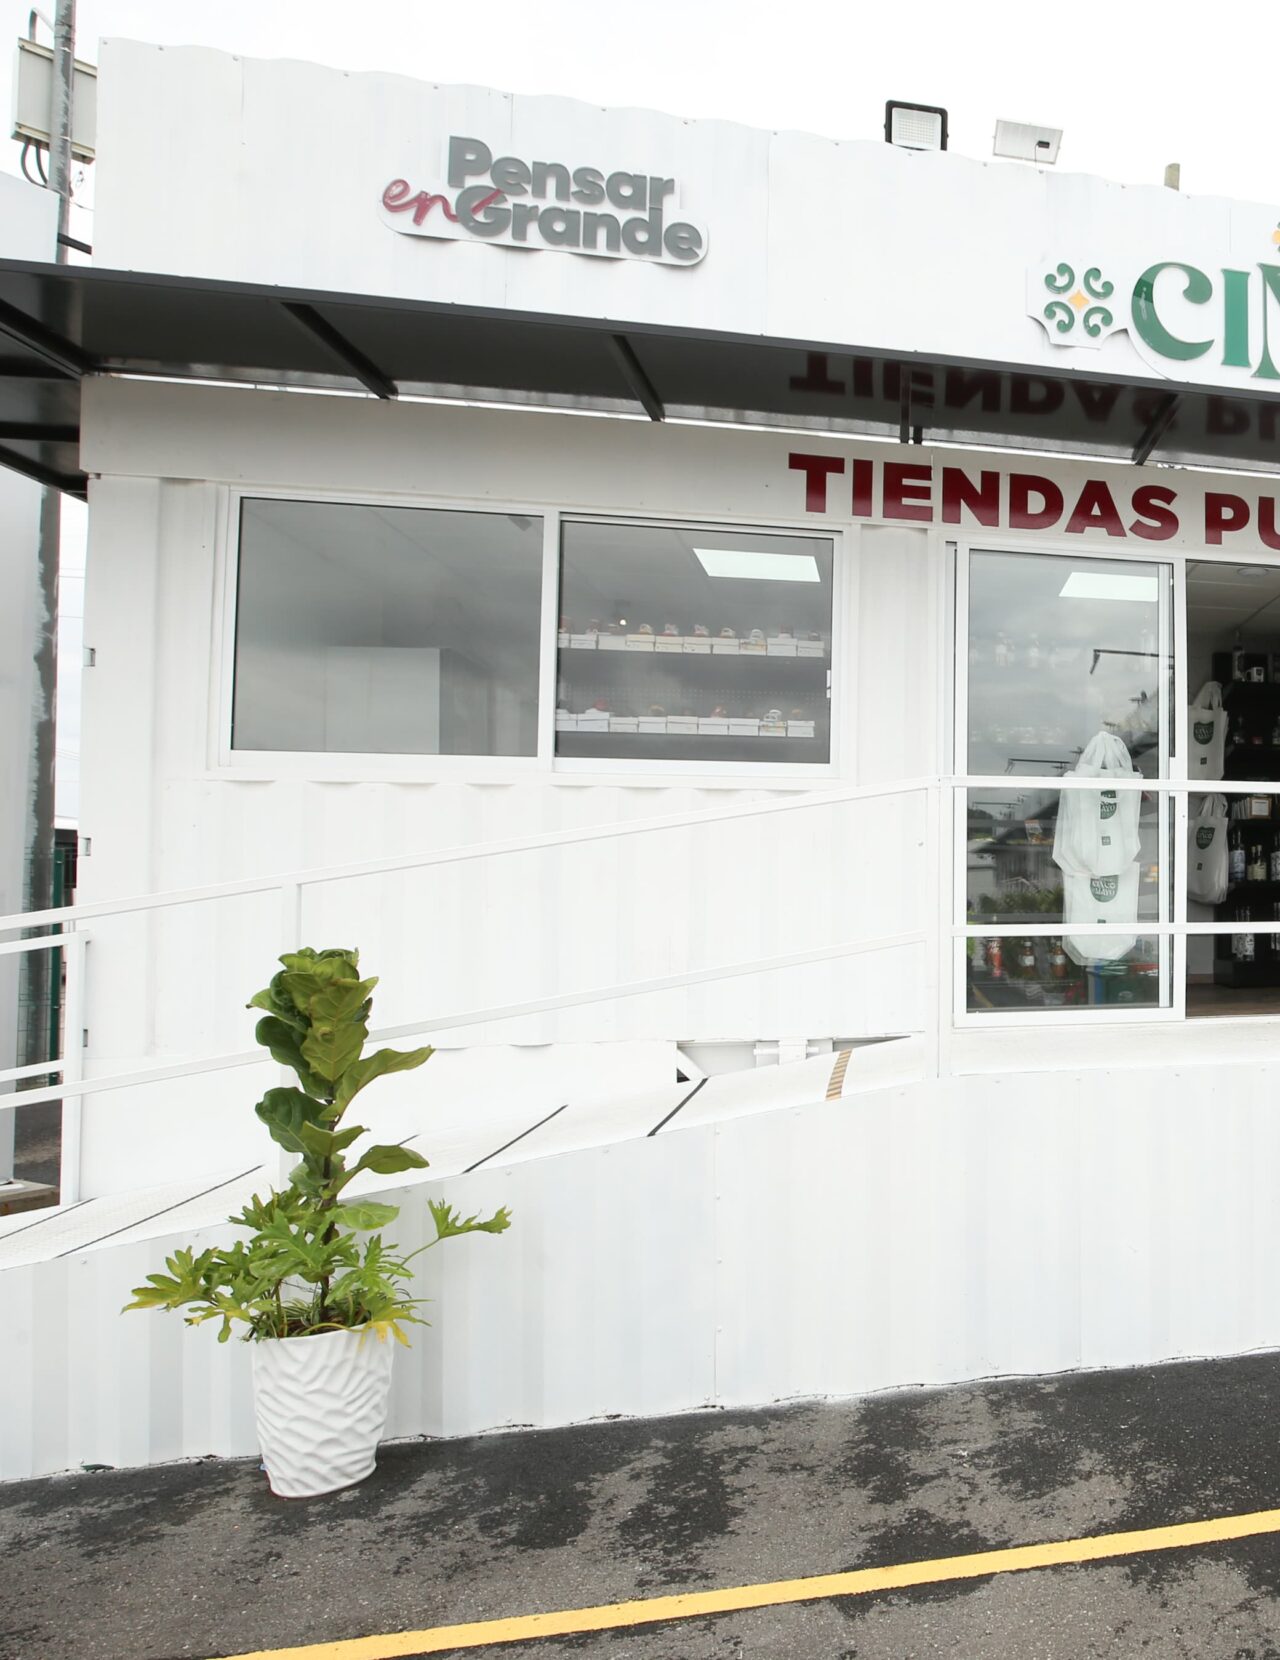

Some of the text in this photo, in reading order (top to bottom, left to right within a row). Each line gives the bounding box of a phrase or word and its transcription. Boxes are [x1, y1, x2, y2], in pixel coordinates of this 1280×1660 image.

[448, 135, 675, 212] Pensar
[382, 178, 703, 260] en Grande
[788, 452, 1180, 541] TIENDAS
